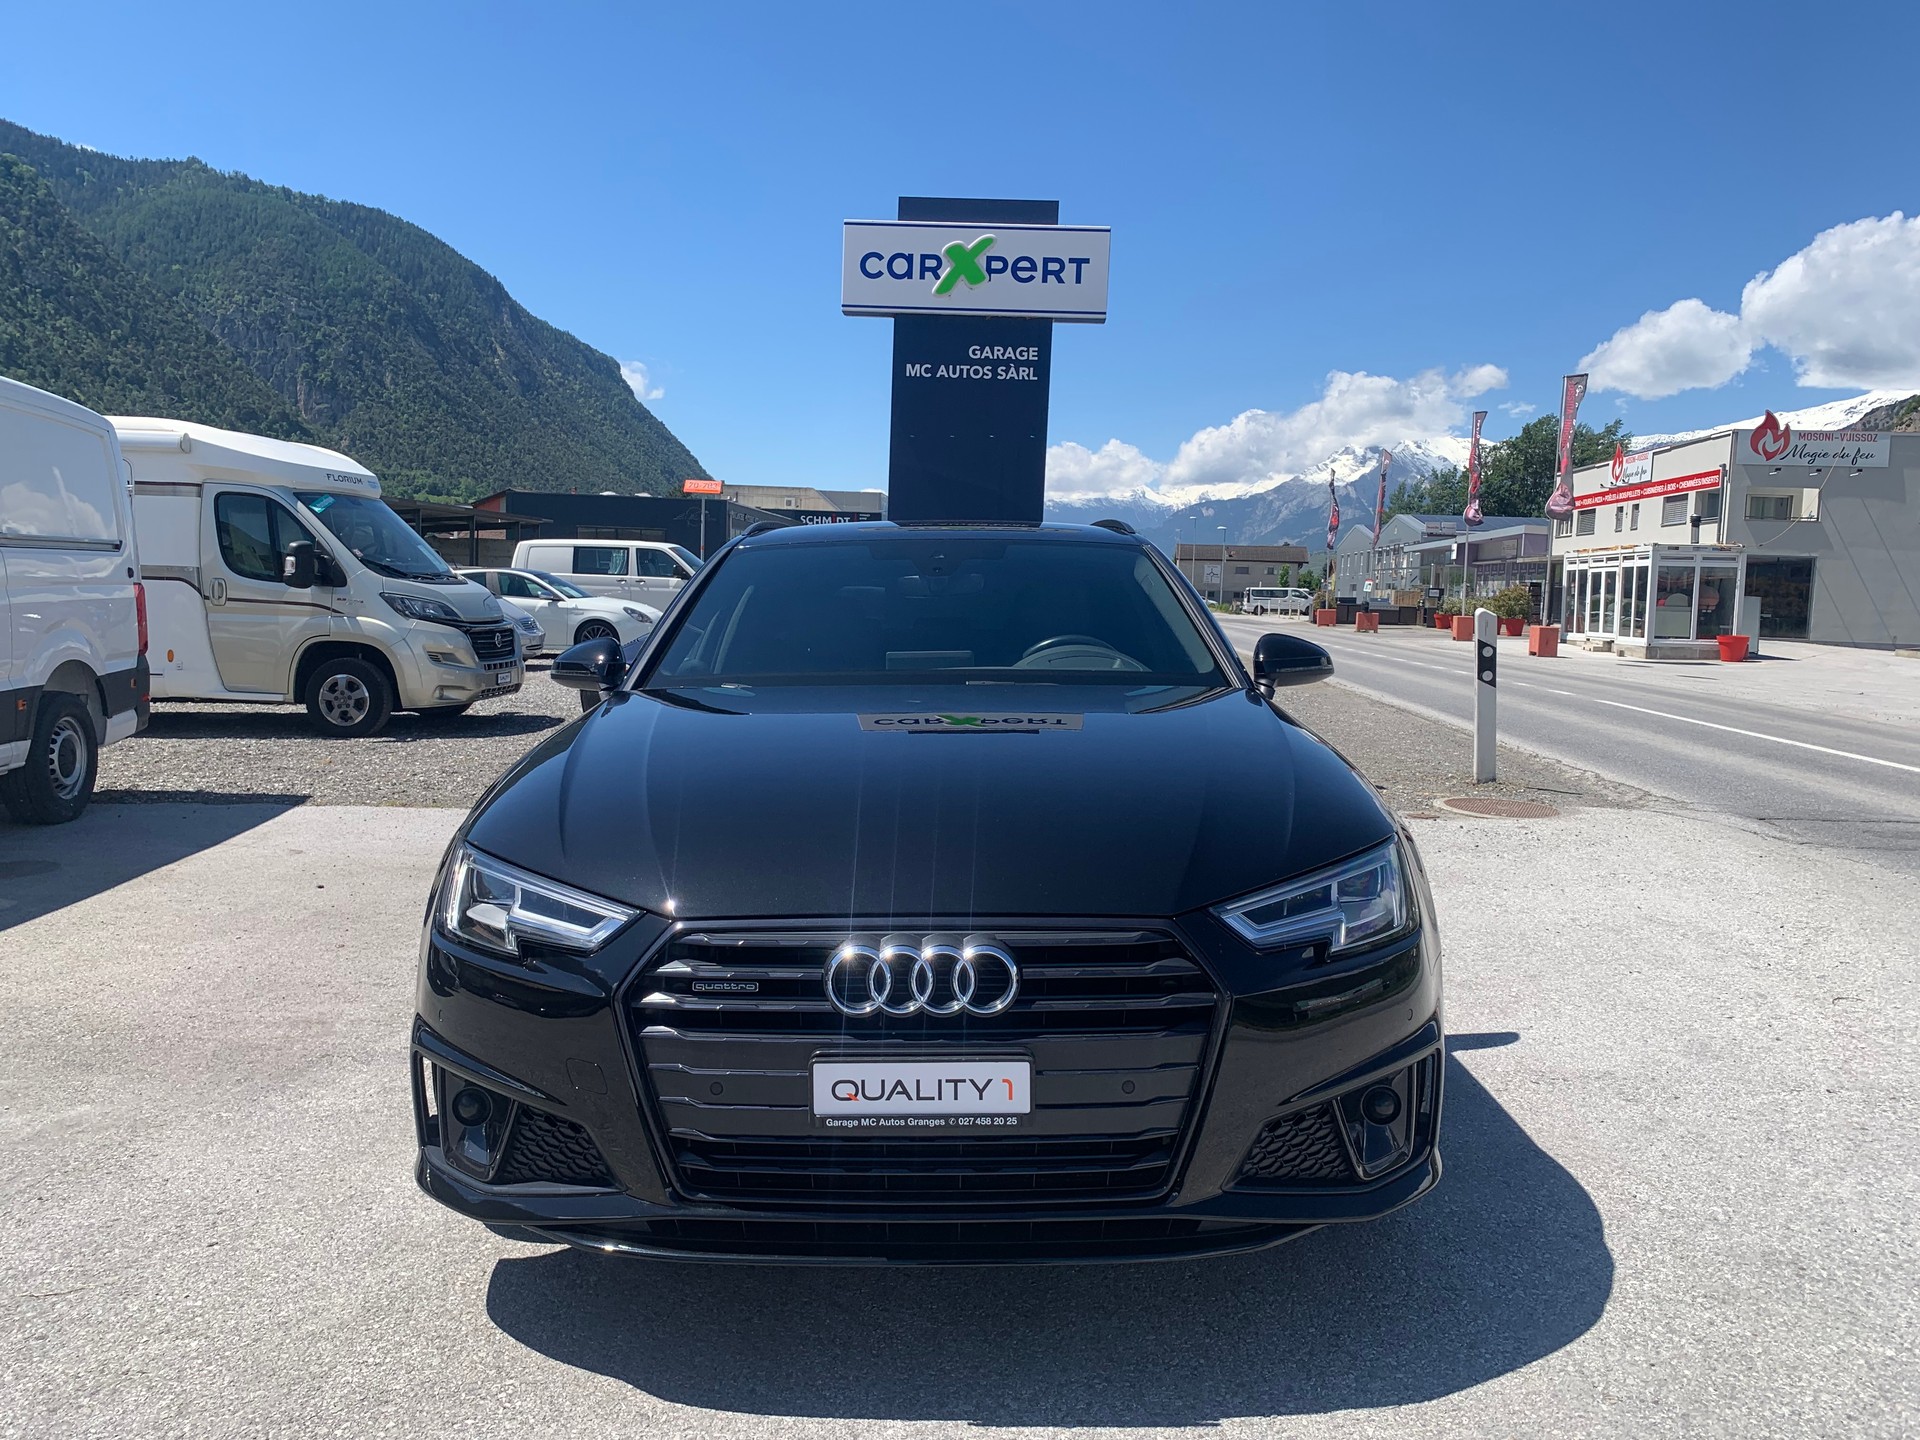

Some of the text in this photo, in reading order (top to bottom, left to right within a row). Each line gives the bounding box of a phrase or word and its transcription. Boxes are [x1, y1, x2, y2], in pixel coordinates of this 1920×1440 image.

[968, 345, 1038, 361] GARAGE
[905, 364, 1038, 380] MC AUTOS SÀRL
[1798, 432, 1878, 443] MOSONI-VUISSOZ
[1779, 443, 1876, 465] Magie du feu
[326, 473, 363, 485] FLORIUM
[800, 513, 851, 525] SCHMIDT
[695, 983, 755, 991] quattro
[831, 1078, 1013, 1101] QUALITY 1
[826, 1117, 1018, 1127] Garage MC Autos Granges 027 458 20 25
